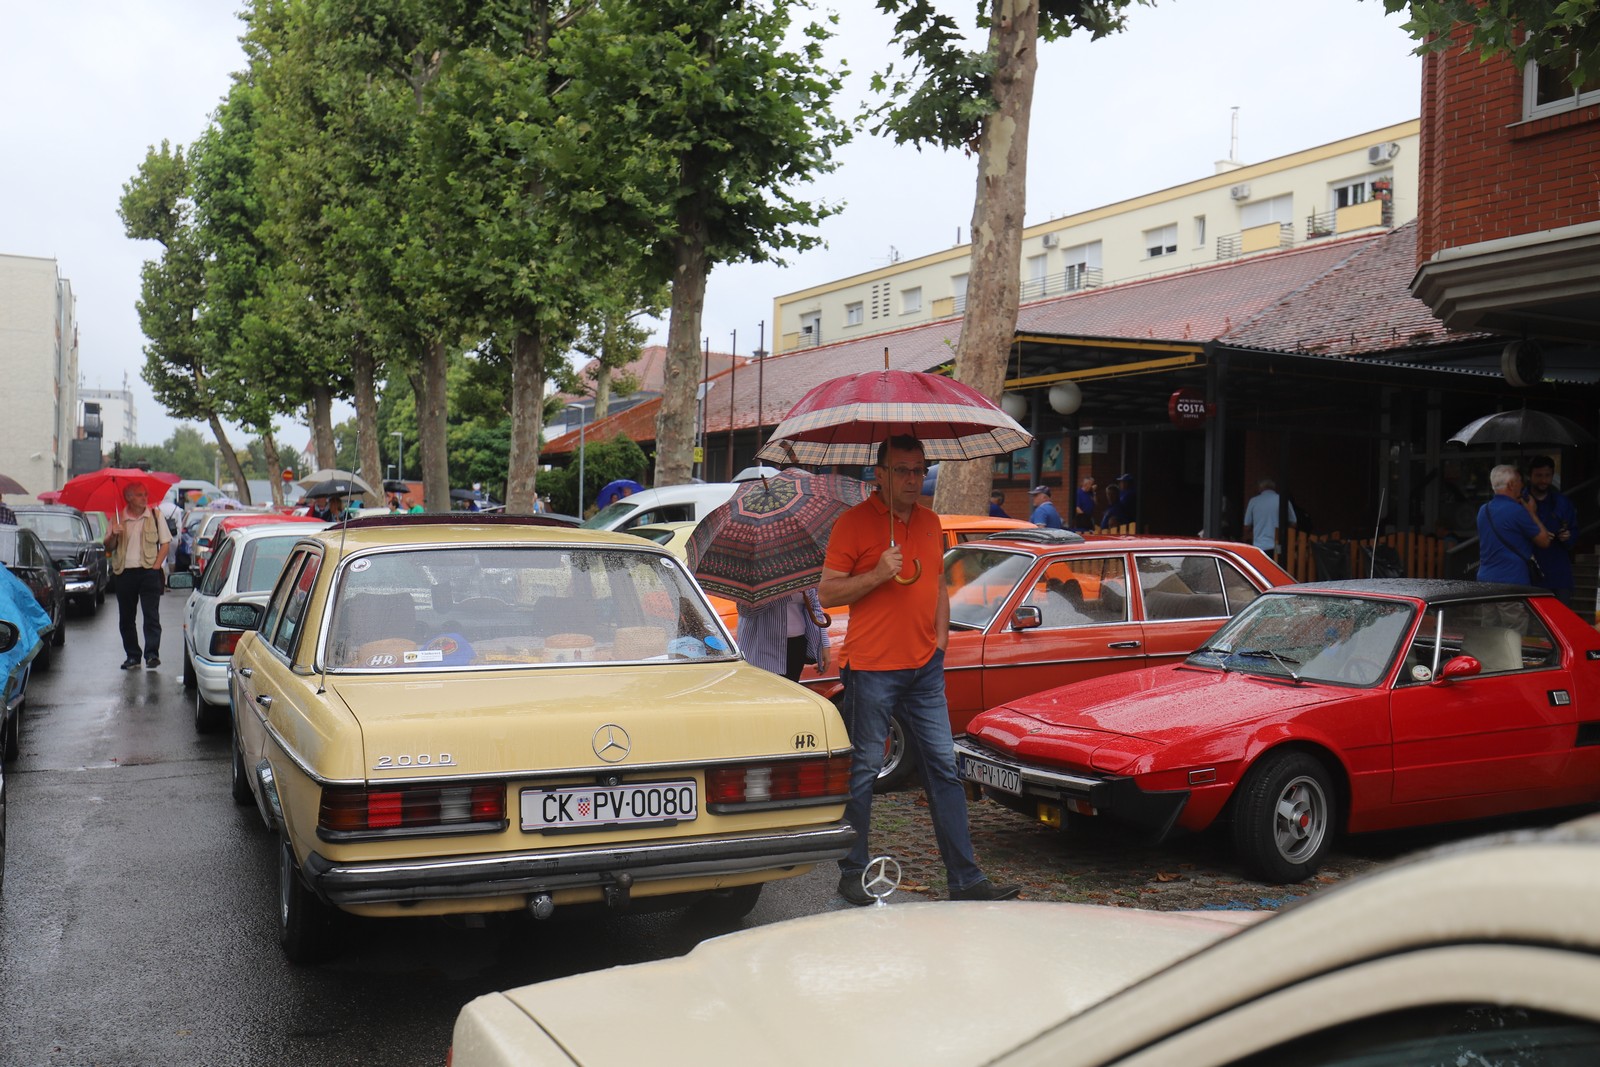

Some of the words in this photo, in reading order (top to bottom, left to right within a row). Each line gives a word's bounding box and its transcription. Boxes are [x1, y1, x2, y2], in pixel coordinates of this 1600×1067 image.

[1177, 403, 1205, 413] COSTA
[370, 655, 393, 666] HR
[795, 734, 816, 749] HR
[542, 793, 574, 823] ČK
